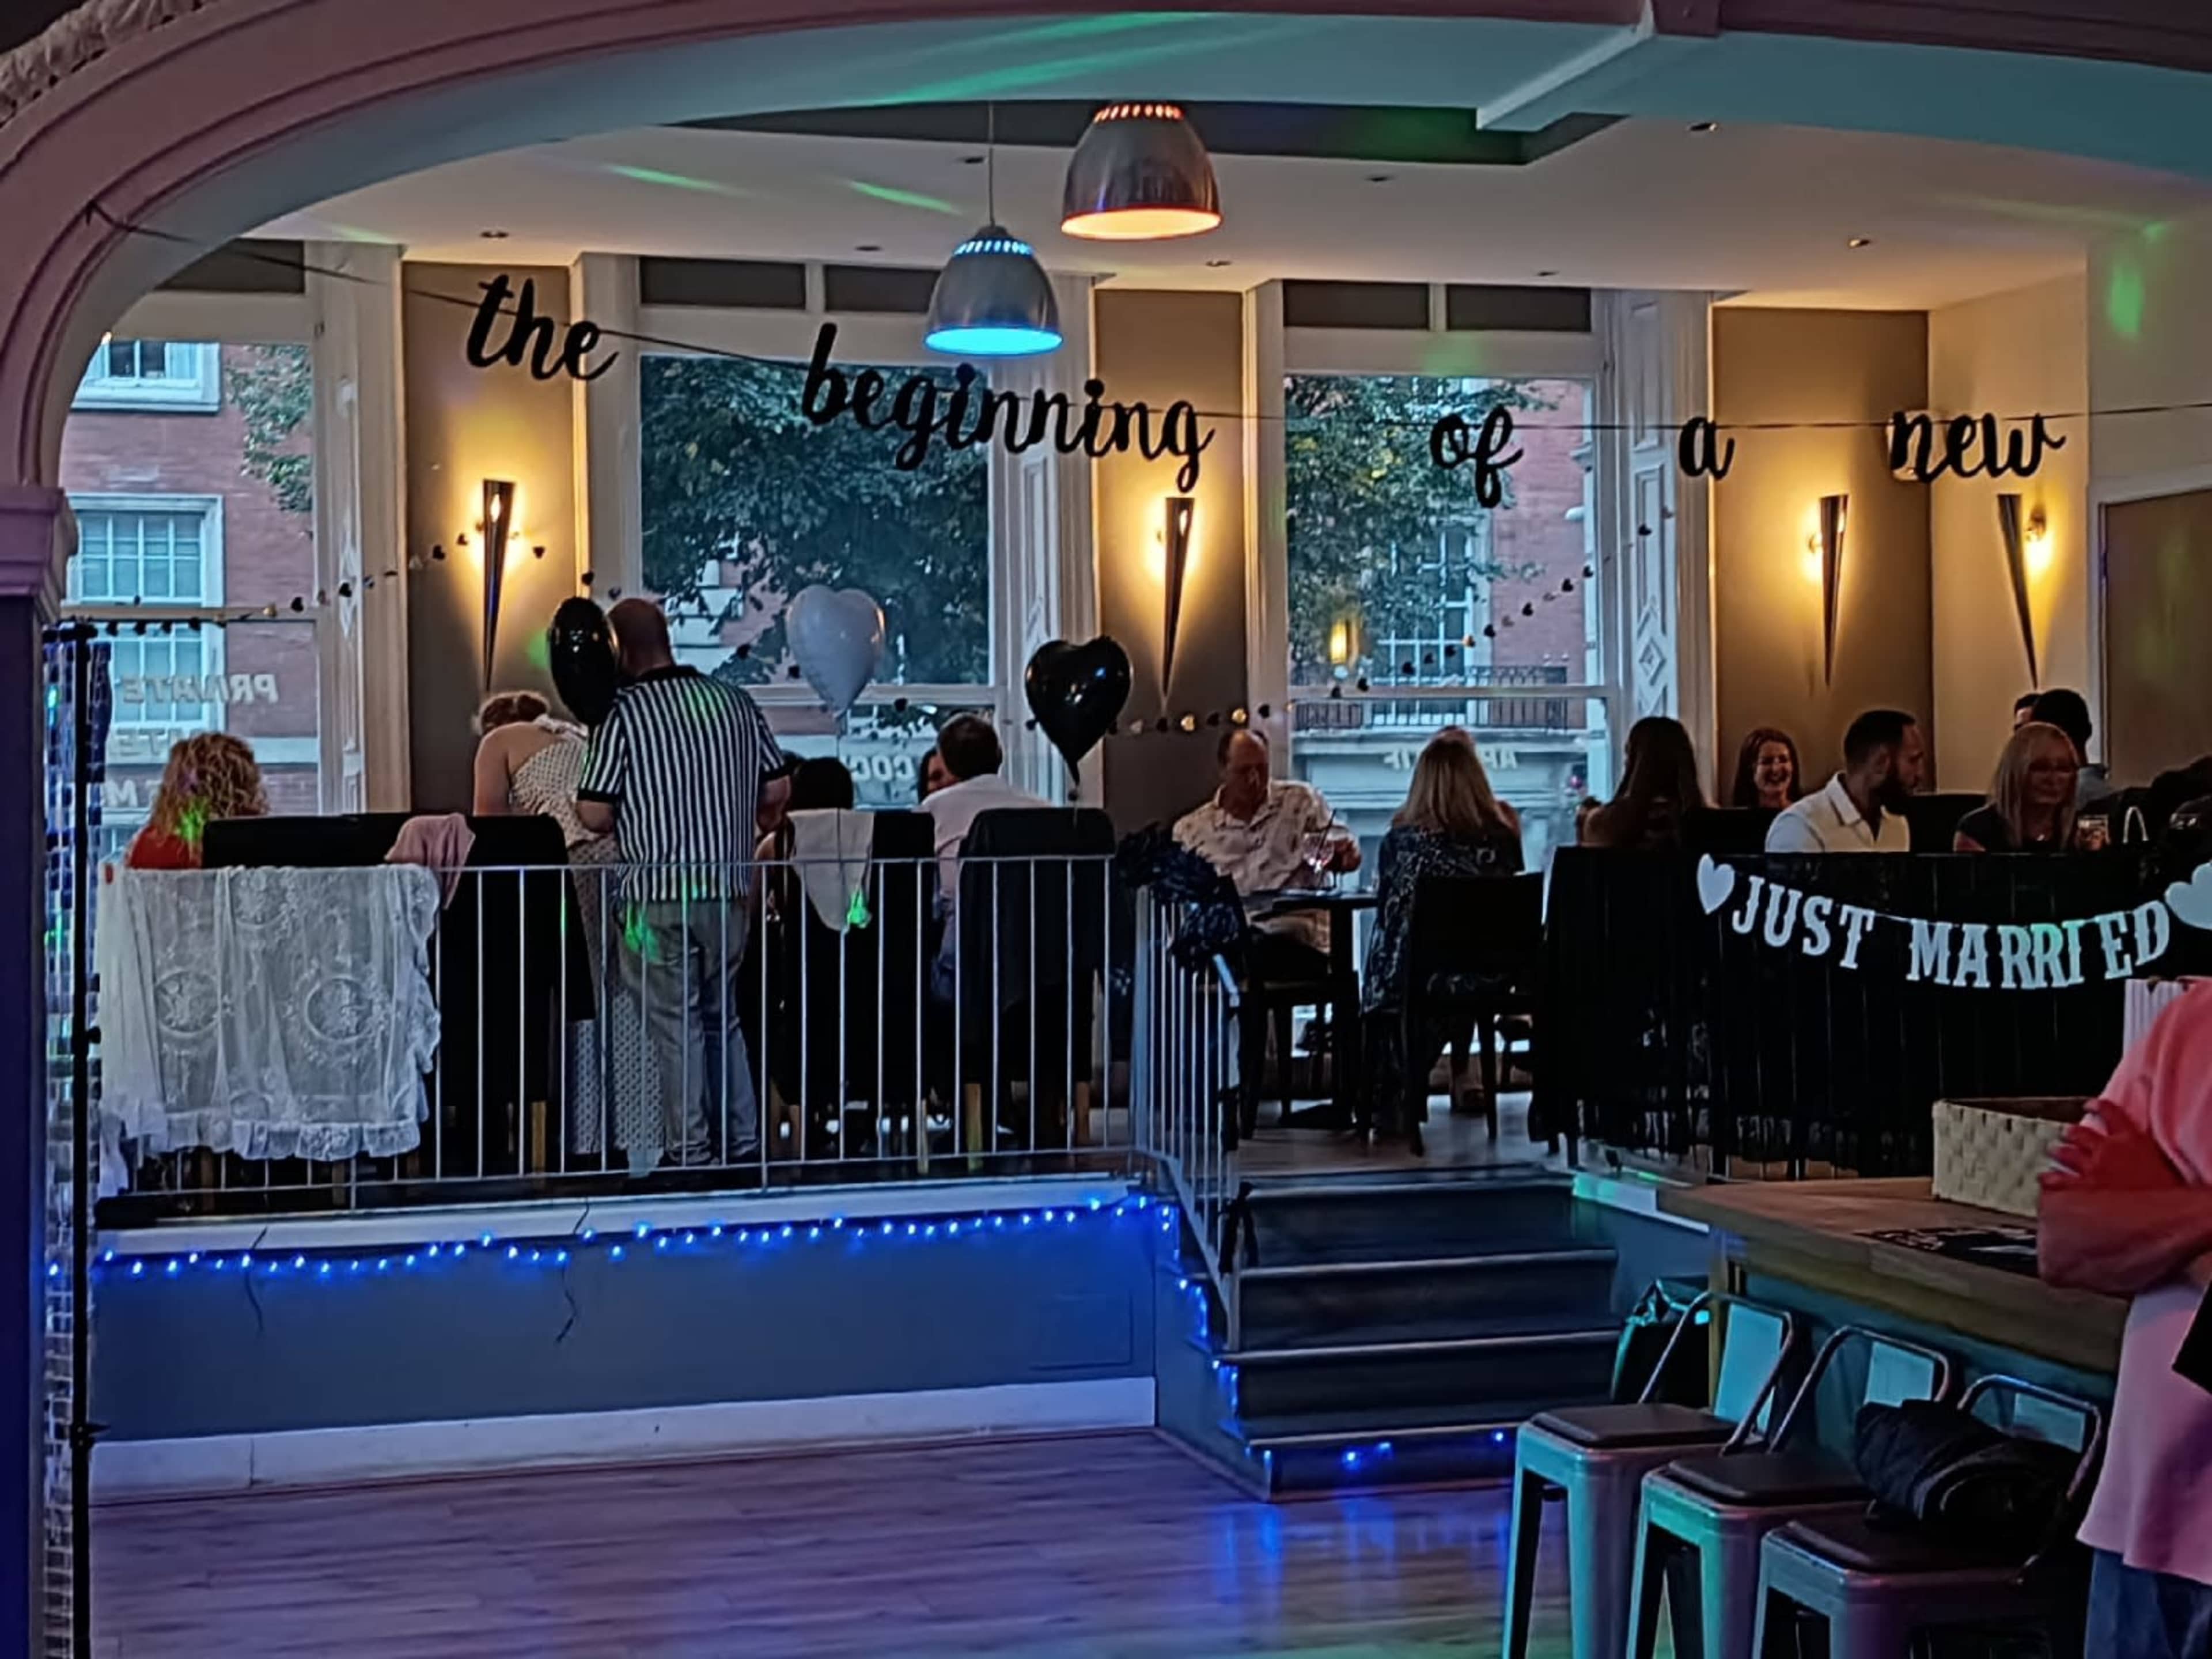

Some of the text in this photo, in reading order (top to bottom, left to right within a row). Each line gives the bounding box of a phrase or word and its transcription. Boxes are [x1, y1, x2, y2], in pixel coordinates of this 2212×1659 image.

[465, 274, 2066, 508] the beginning of a new
[1732, 875, 2171, 990] JUST MARRIED
